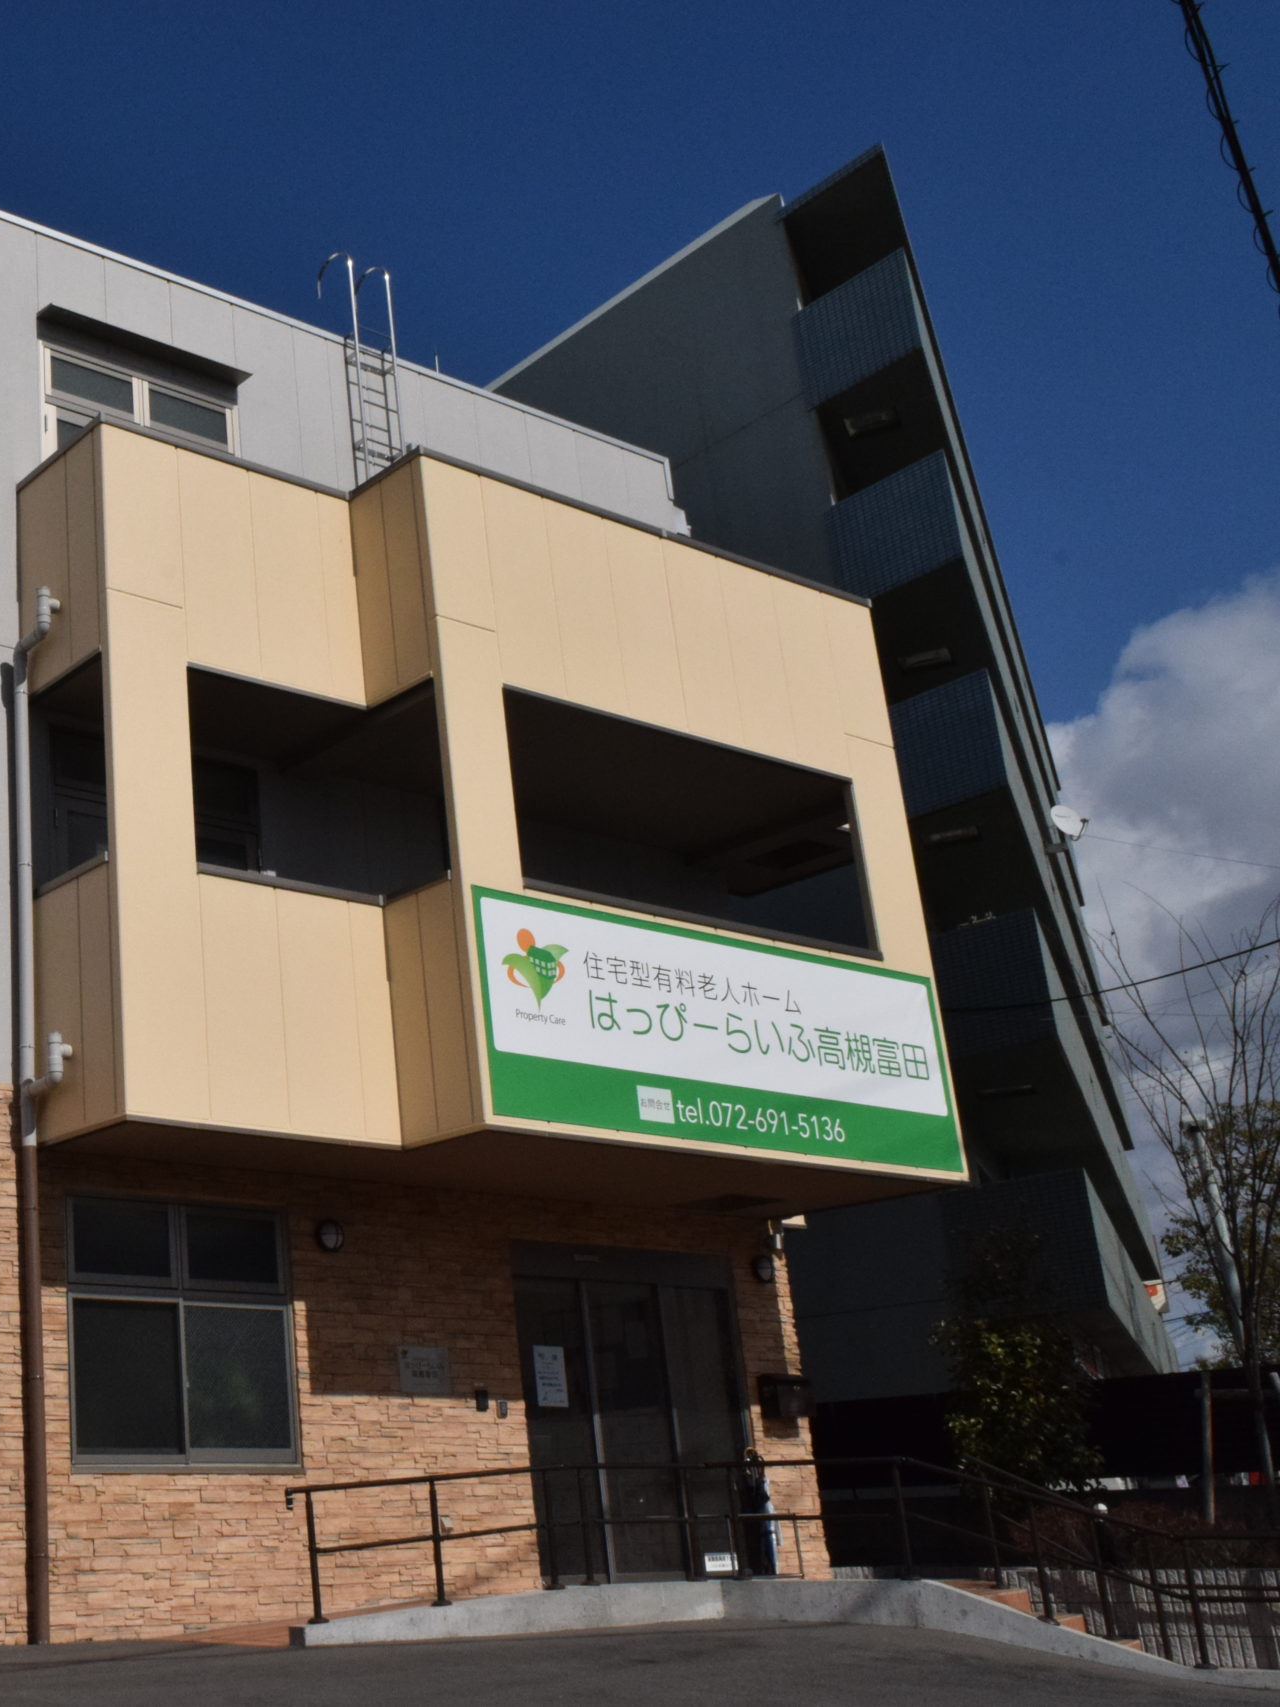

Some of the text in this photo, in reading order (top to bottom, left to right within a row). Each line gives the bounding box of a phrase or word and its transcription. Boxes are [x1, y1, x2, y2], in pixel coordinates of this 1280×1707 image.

[583, 951, 802, 1015] 住宅型有料老人ホーム
[515, 1007, 567, 1026] Property Care
[588, 989, 930, 1081] はっぴーらいふ高槻富田
[676, 1097, 846, 1143] tel.072-691-5136
